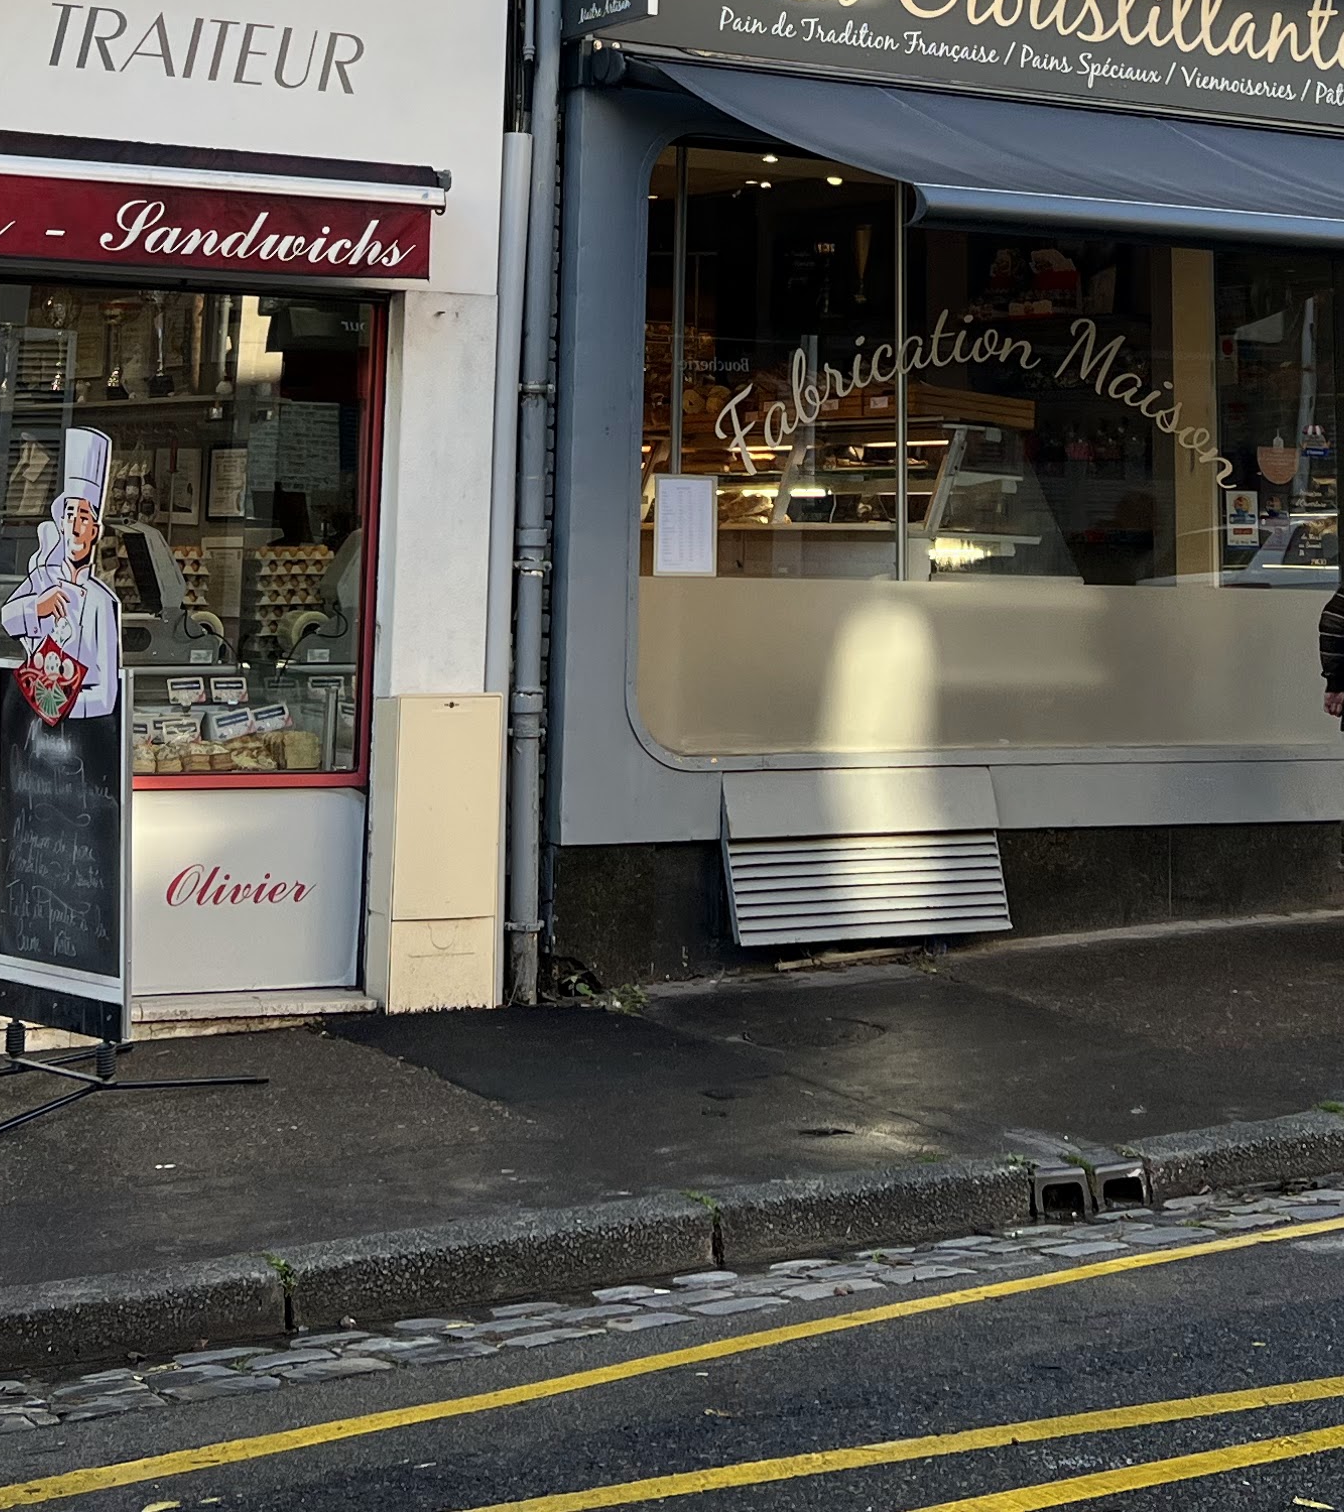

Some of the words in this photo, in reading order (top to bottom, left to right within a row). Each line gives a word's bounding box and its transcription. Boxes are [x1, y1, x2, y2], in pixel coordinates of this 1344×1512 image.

[49, 2, 365, 95] TRAITEUR
[719, 5, 768, 36] Pain
[771, 11, 797, 40] de
[800, 16, 899, 52] Tradition
[903, 31, 1000, 65] Française
[1020, 44, 1072, 75] Pains
[1076, 53, 1162, 88] Spéciaux
[1181, 65, 1297, 102] Viennoiseries
[99, 199, 419, 268] Sandwichs
[715, 308, 1041, 477] Fabrication
[1055, 318, 1237, 488] Maison
[165, 863, 317, 909] Olivier
